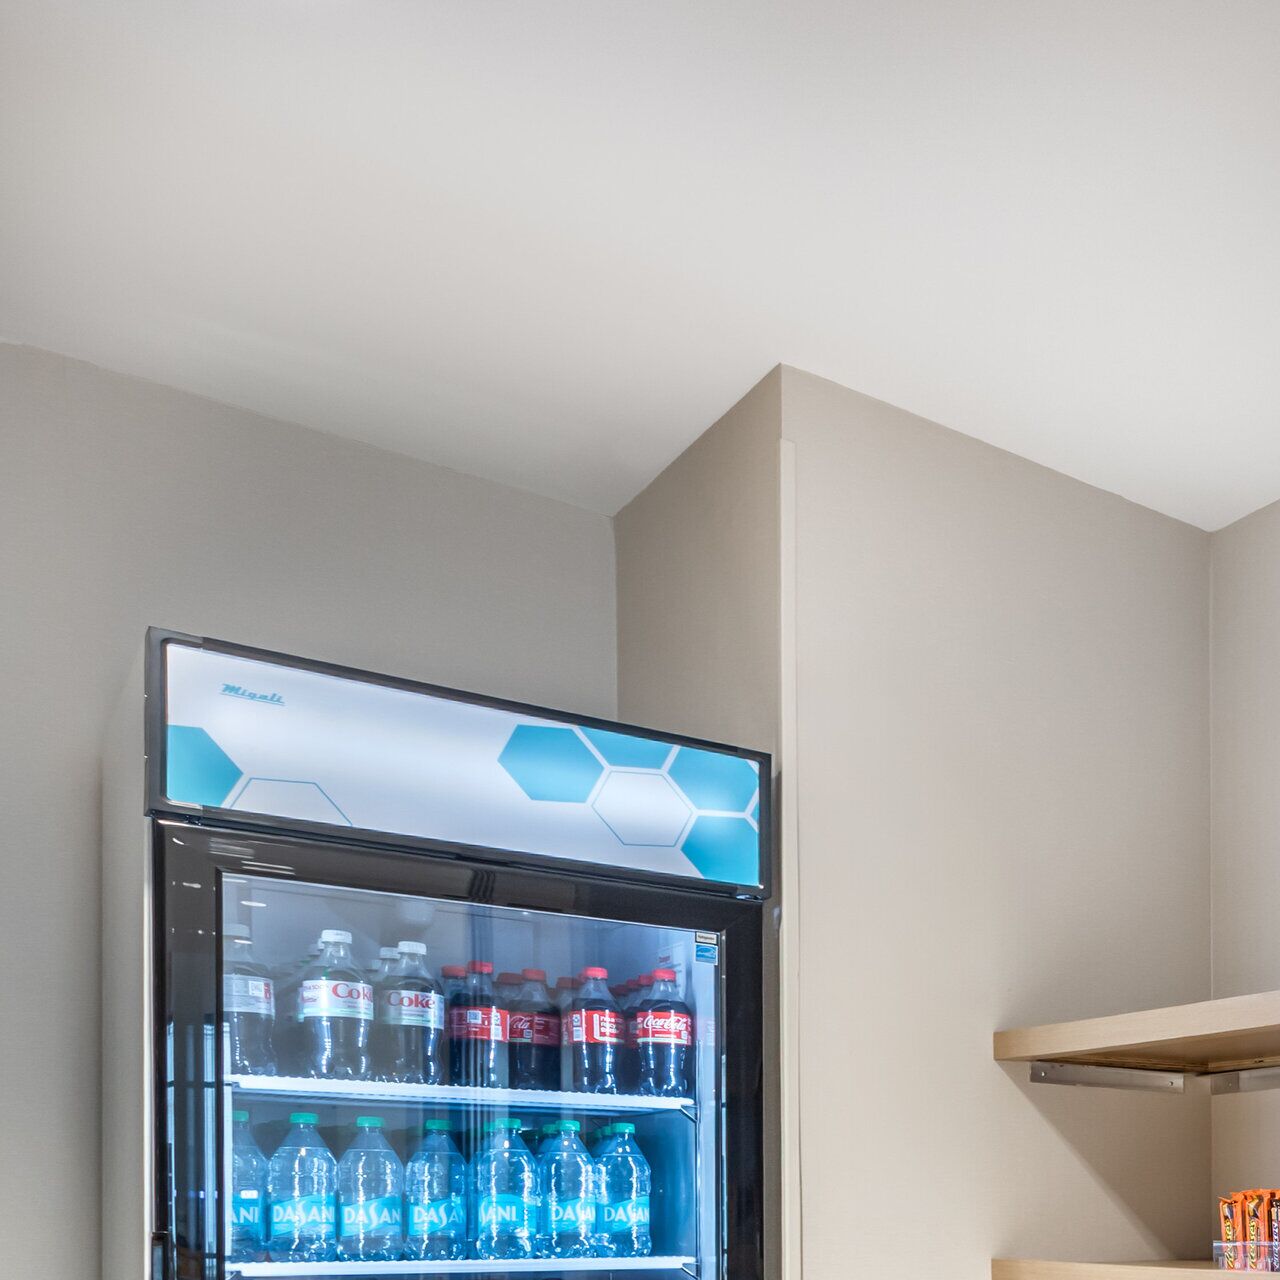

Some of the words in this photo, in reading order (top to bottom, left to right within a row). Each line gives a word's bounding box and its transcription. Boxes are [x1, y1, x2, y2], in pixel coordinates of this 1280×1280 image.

[221, 683, 285, 704] Migali
[387, 991, 435, 1009] Coke
[273, 1200, 335, 1225] DASAN
[344, 1201, 400, 1228] DASAN
